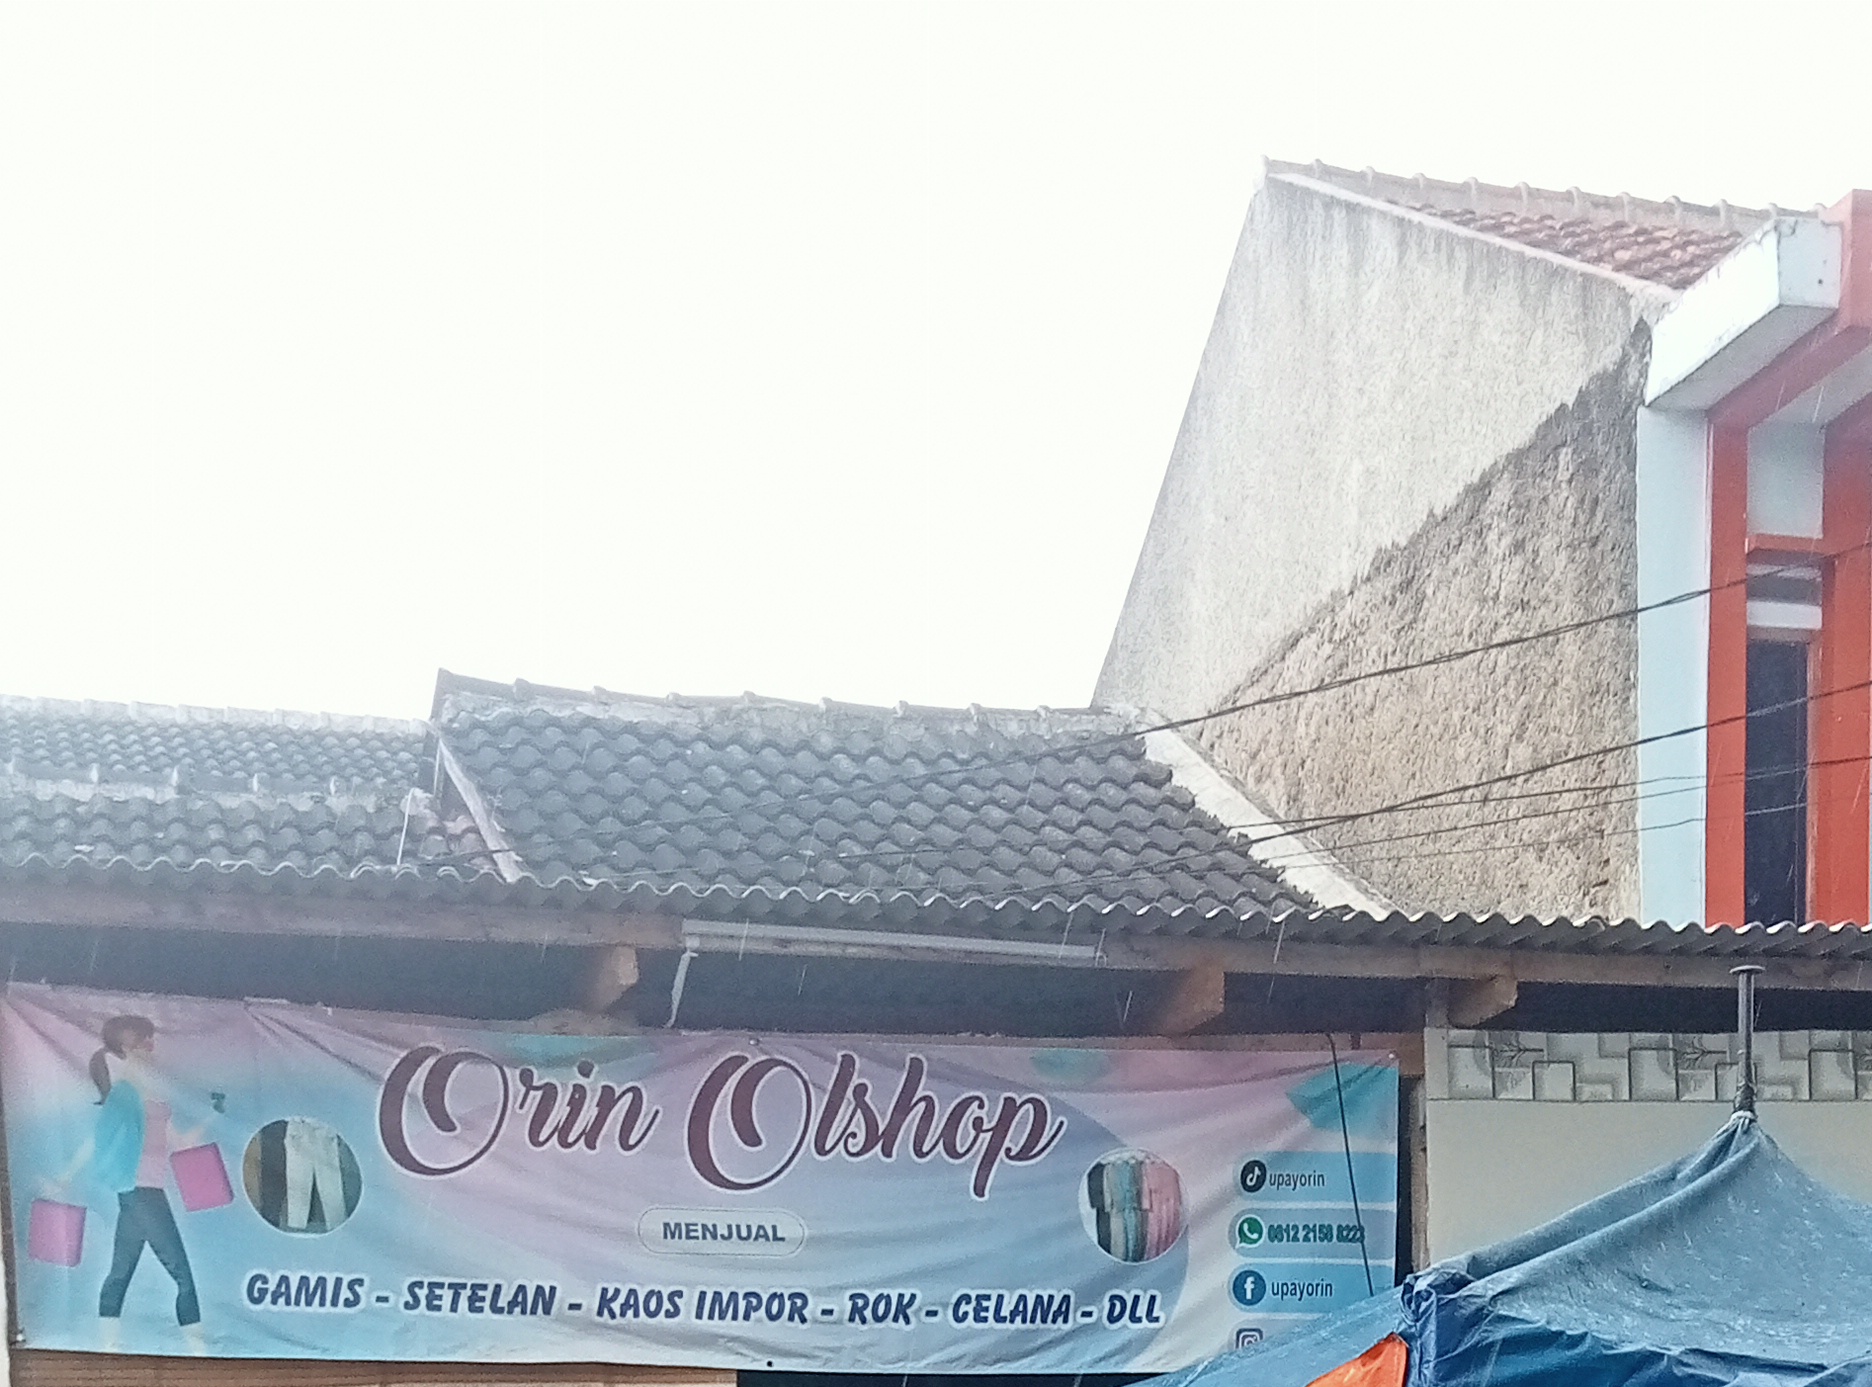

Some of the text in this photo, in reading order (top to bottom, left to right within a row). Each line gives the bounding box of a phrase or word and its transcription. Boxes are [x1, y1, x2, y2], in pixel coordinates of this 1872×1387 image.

[379, 1046, 1064, 1198] Orin Olshop
[1269, 1171, 1326, 1192] upayorin
[661, 1221, 787, 1243] MENJUAL
[246, 1273, 365, 1308] GAMIS
[403, 1280, 558, 1316] SETELAN
[596, 1286, 684, 1320] KAOS
[695, 1290, 810, 1324] IMPOR
[848, 1292, 917, 1324] ROK
[951, 1293, 1072, 1326] CELANA
[1105, 1294, 1161, 1324] DLL
[1271, 1278, 1333, 1302] upayorin
